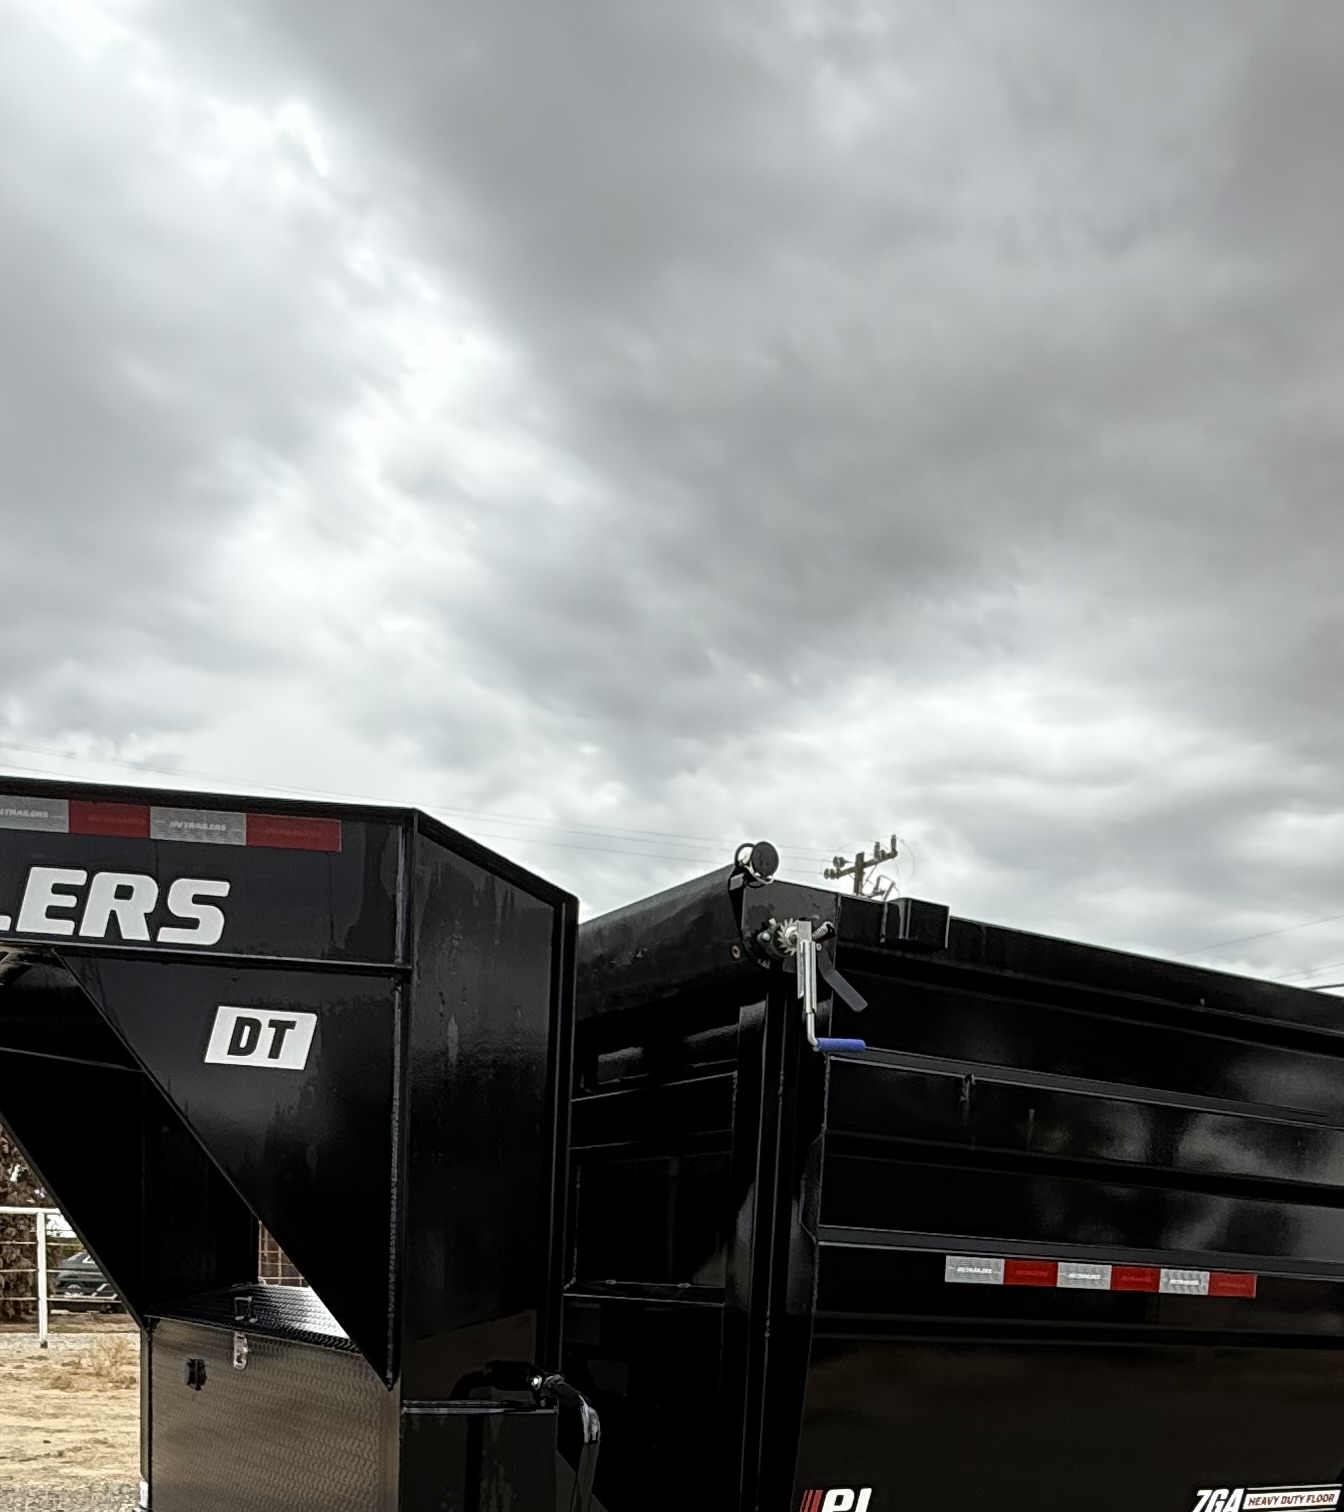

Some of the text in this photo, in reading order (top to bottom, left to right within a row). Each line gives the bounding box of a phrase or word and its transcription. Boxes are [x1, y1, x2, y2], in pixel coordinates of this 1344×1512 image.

[226, 1015, 297, 1061] DT
[1247, 1495, 1280, 1507] HEAVY
[1280, 1494, 1305, 1505] DUTY
[1306, 1492, 1336, 1504] FLOOR
